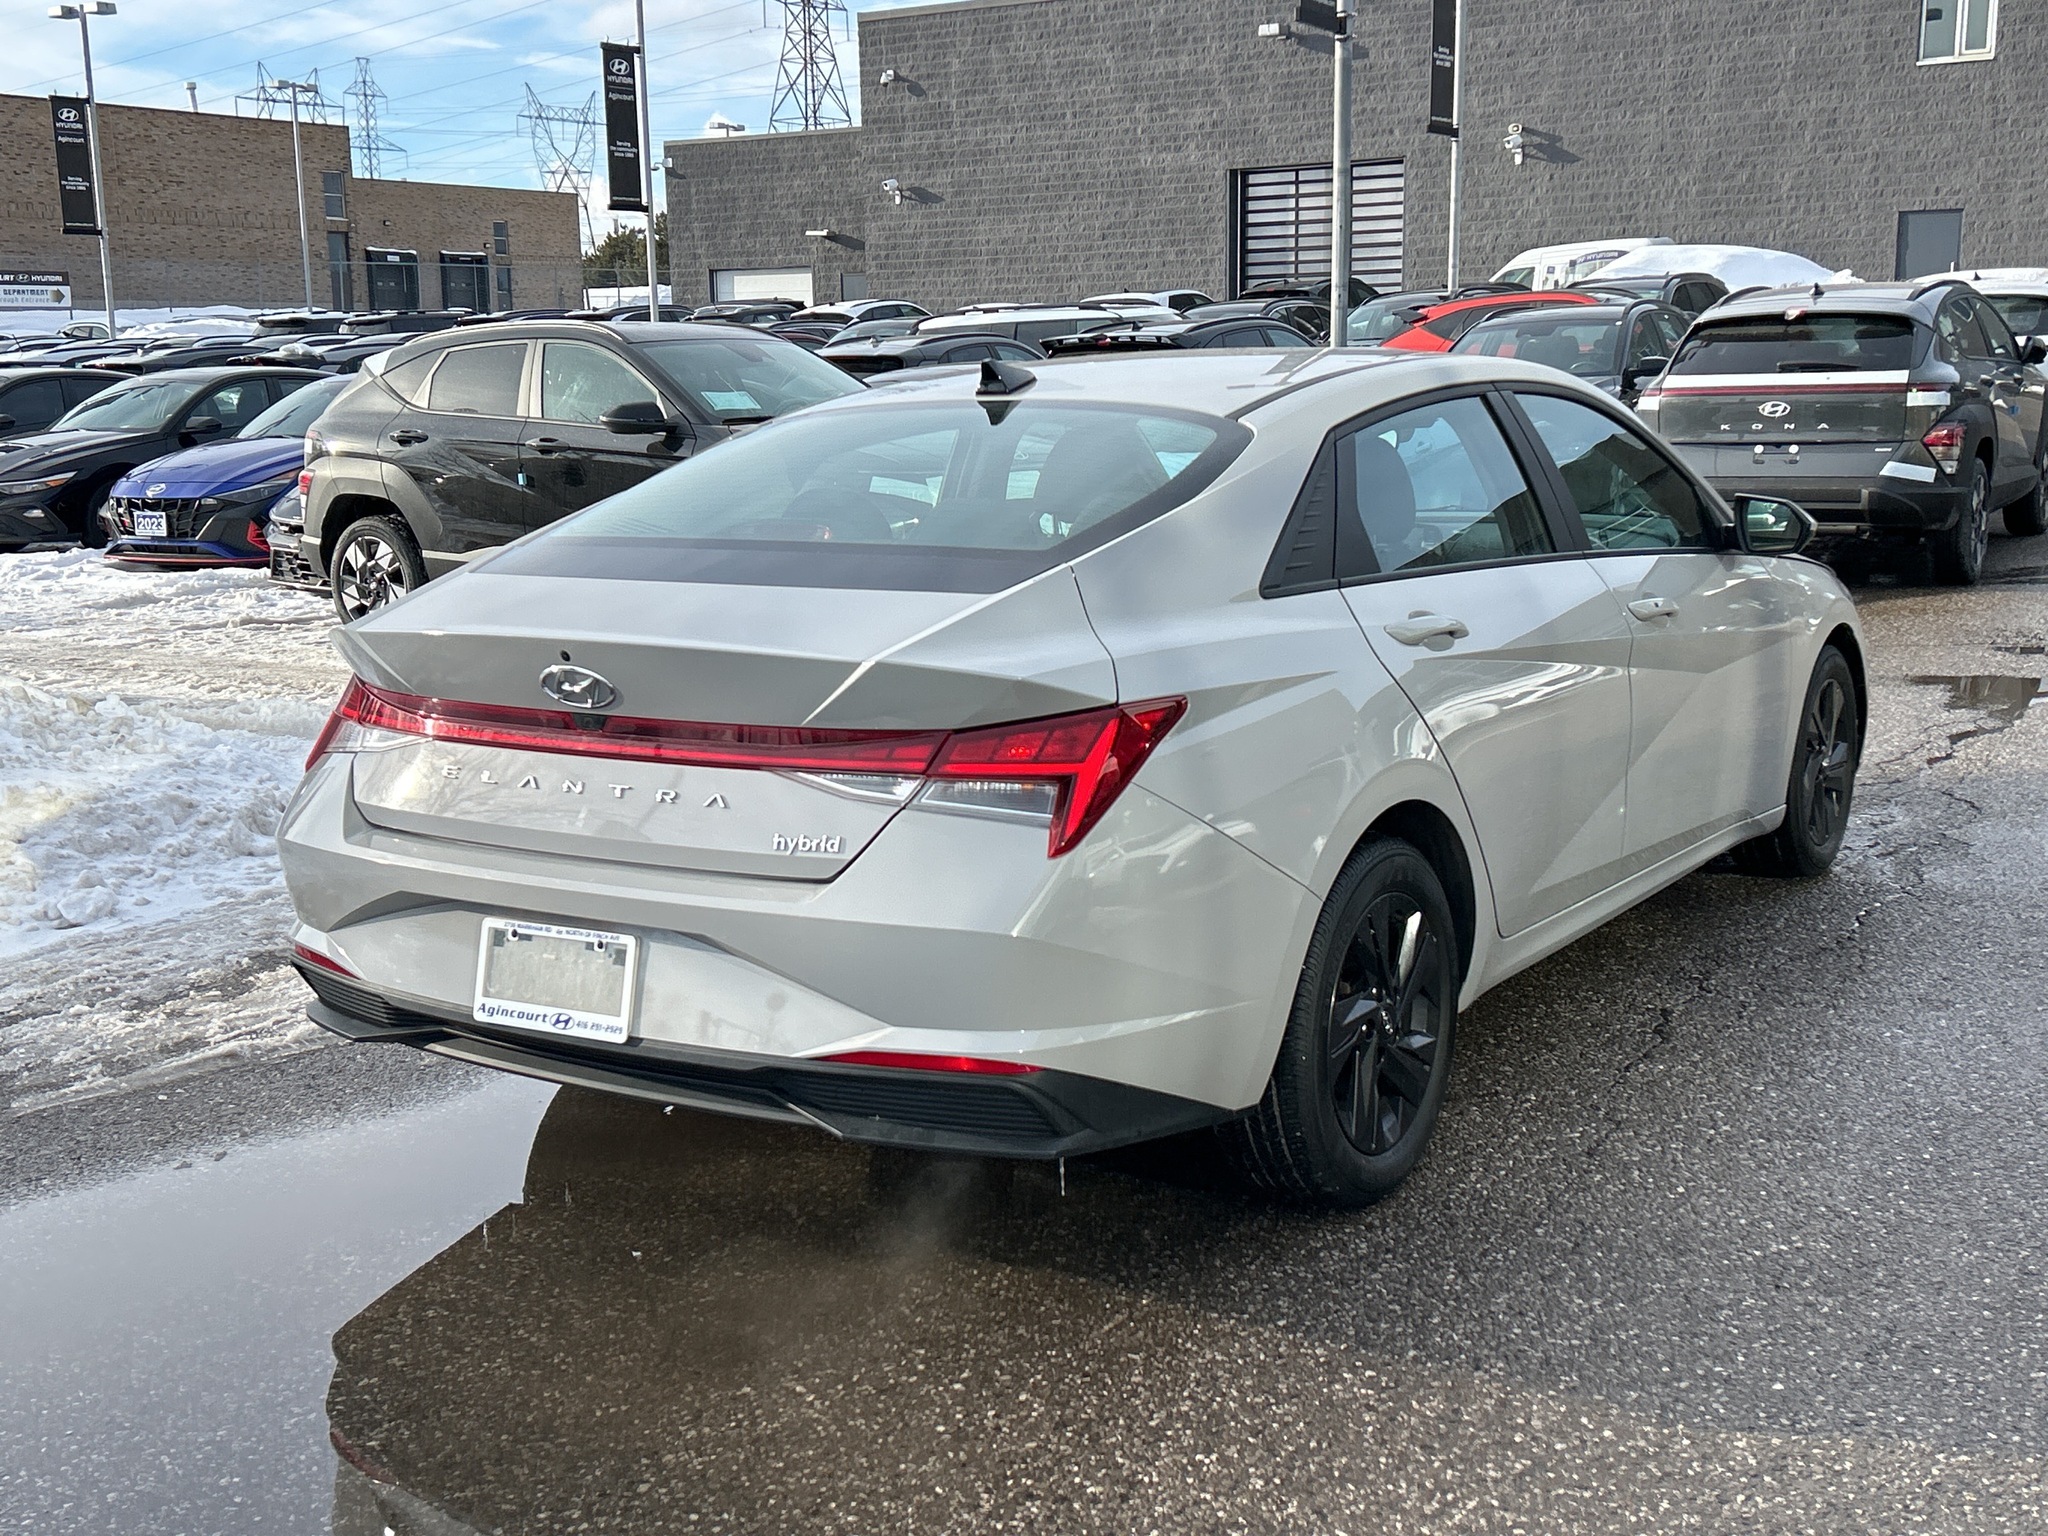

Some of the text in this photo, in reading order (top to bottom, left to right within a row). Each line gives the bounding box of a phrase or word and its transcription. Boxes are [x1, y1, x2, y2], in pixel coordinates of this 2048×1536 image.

[607, 74, 634, 85] HYUNDAI
[608, 91, 635, 101] Agincourt
[55, 121, 84, 130] HYUNDAI
[57, 135, 85, 144] Agincourt
[3, 288, 49, 296] DEPARTMENT
[1720, 422, 1830, 431] KONA
[137, 517, 164, 530] 2023
[441, 763, 731, 809] ELANTRA
[772, 832, 844, 856] hybrid
[476, 1002, 549, 1023] Agincourt
